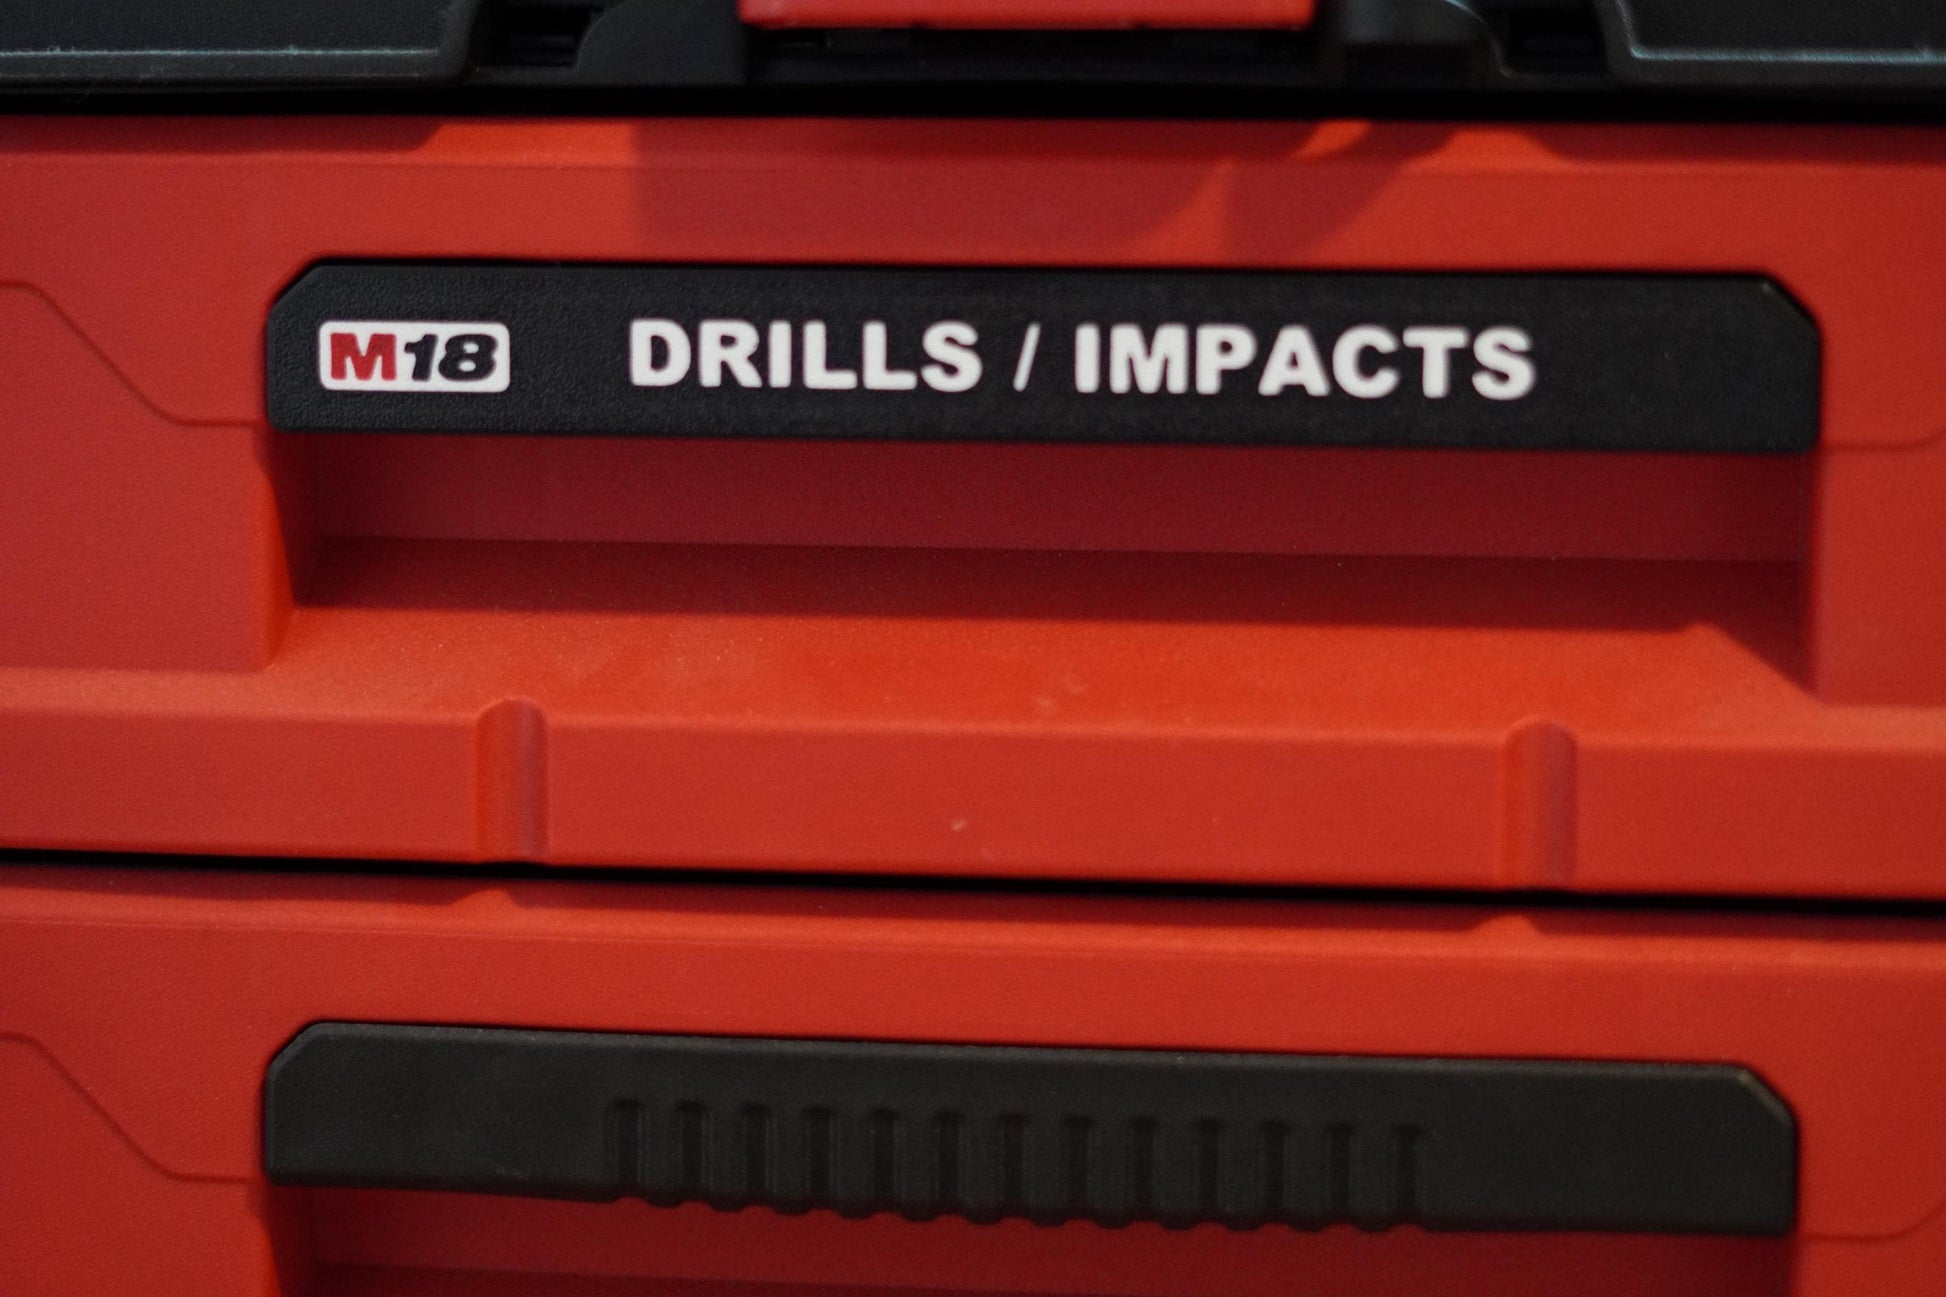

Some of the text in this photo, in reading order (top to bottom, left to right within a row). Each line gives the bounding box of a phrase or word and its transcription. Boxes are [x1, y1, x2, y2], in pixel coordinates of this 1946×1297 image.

[329, 332, 497, 383] M18
[629, 318, 983, 393] DRILLS
[1075, 324, 1534, 400] IMPACTS
